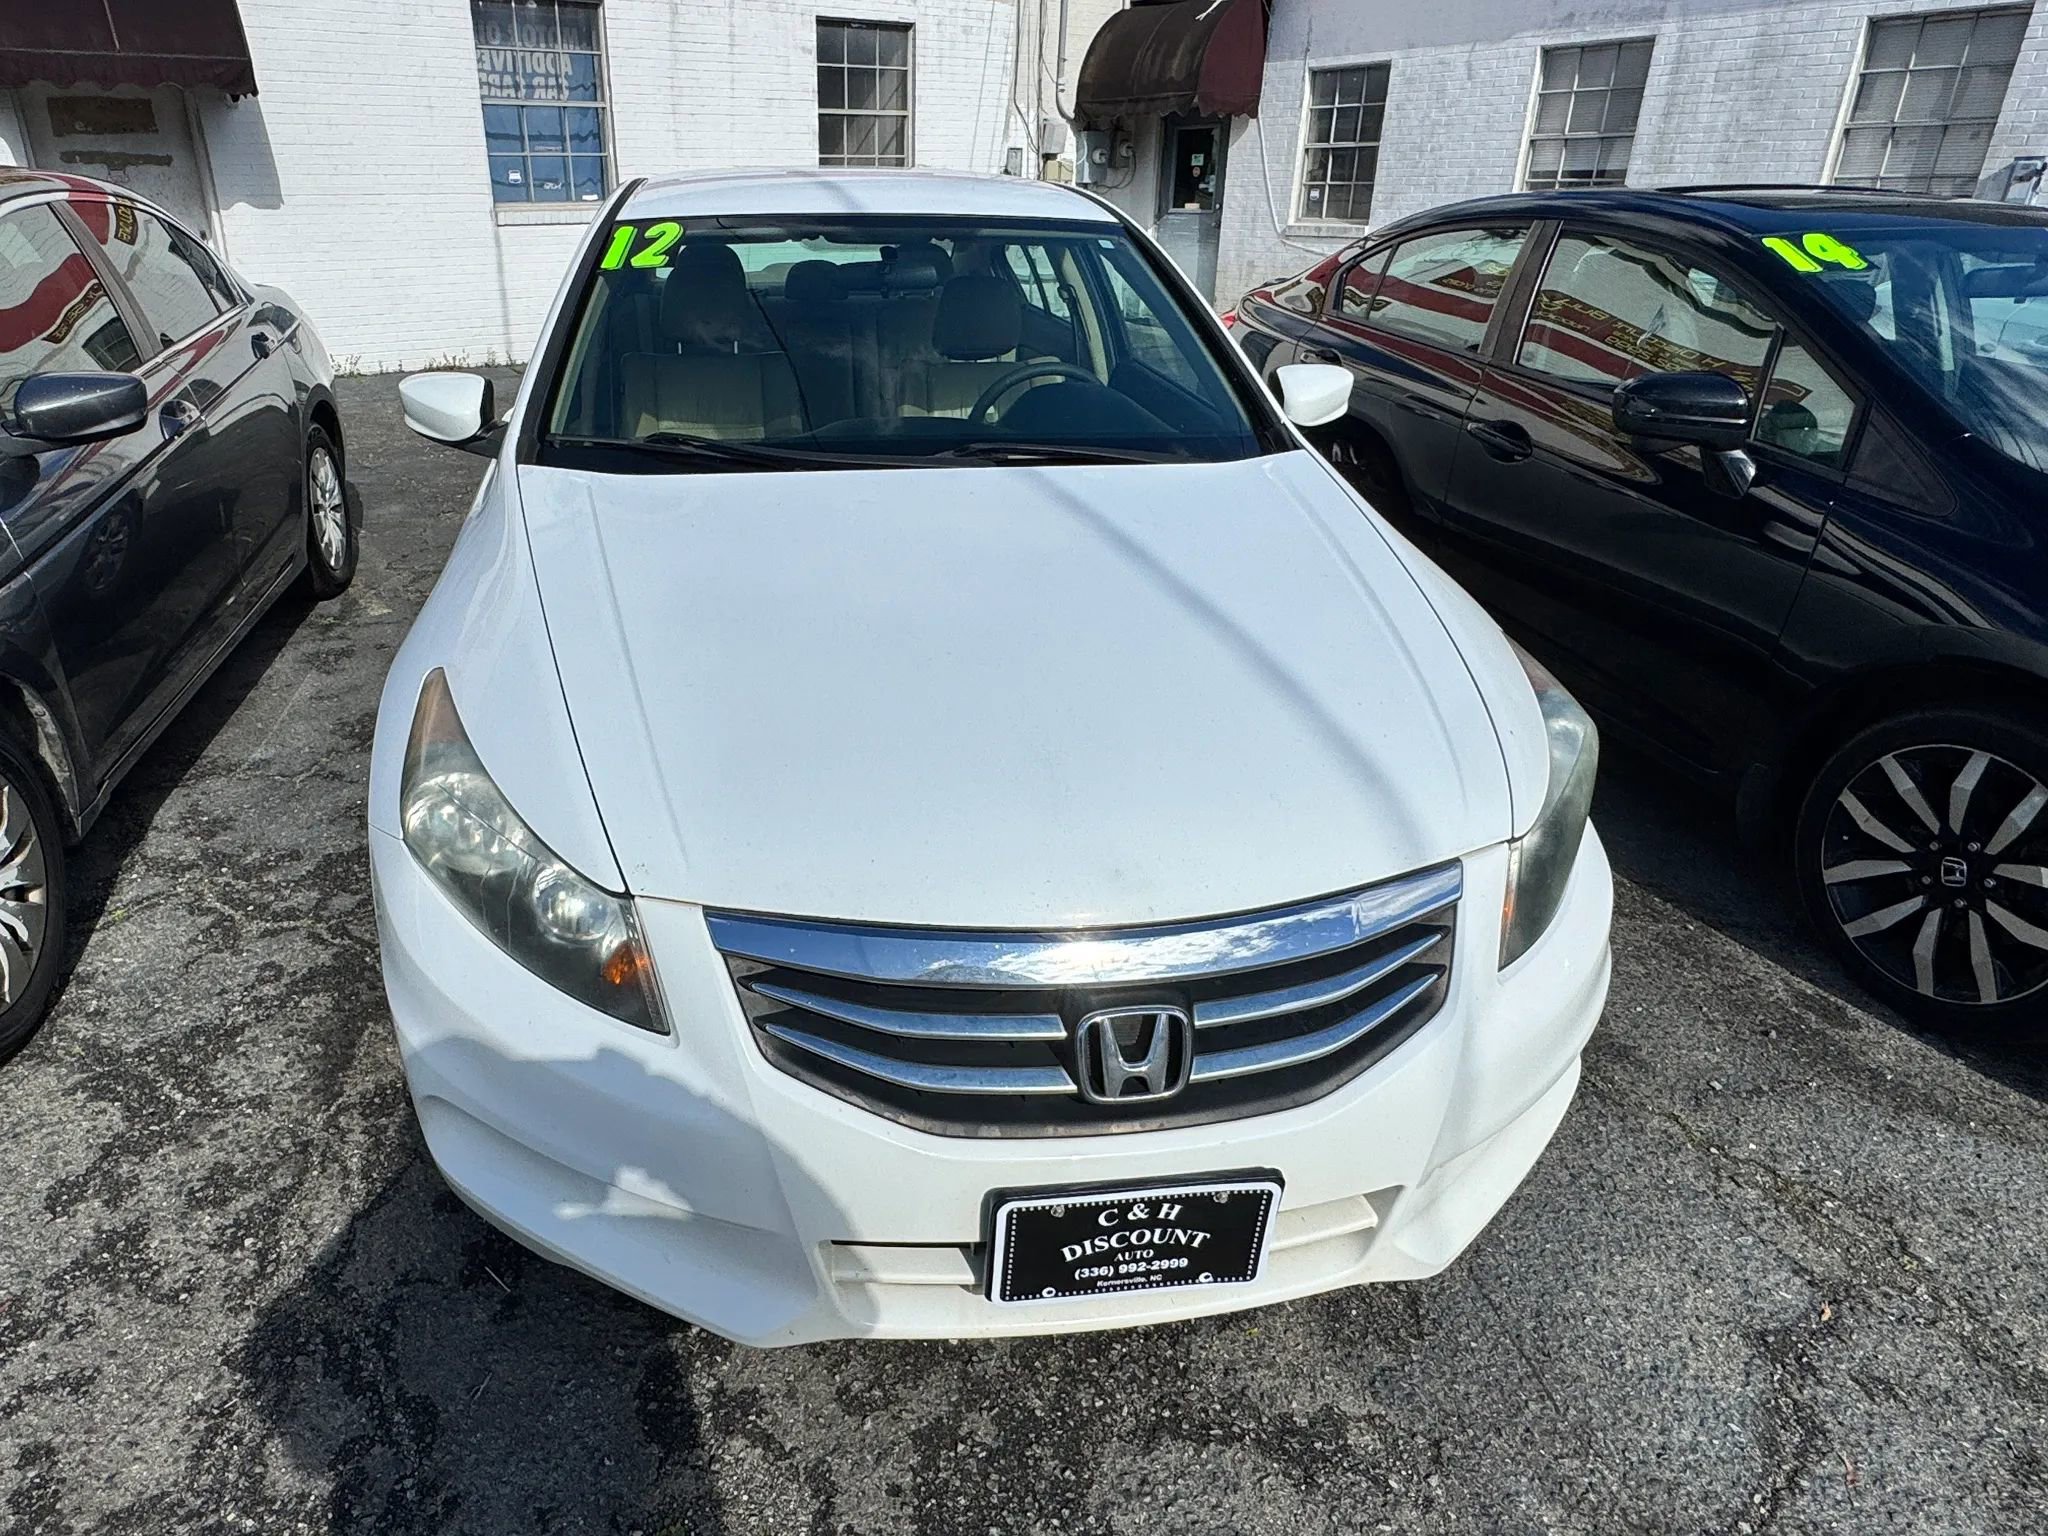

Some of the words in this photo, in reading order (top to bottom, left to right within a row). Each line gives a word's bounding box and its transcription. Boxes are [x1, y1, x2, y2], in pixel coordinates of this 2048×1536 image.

[600, 221, 685, 270] 12
[1761, 232, 1869, 273] 14
[1098, 1208, 1119, 1226] C
[1127, 1202, 1150, 1220] &
[1156, 1202, 1184, 1221] H
[1060, 1228, 1211, 1263] DISCOUNT
[1114, 1249, 1155, 1262] AUTO
[1074, 1265, 1115, 1280] (336)
[1118, 1257, 1188, 1274] 992-2999
